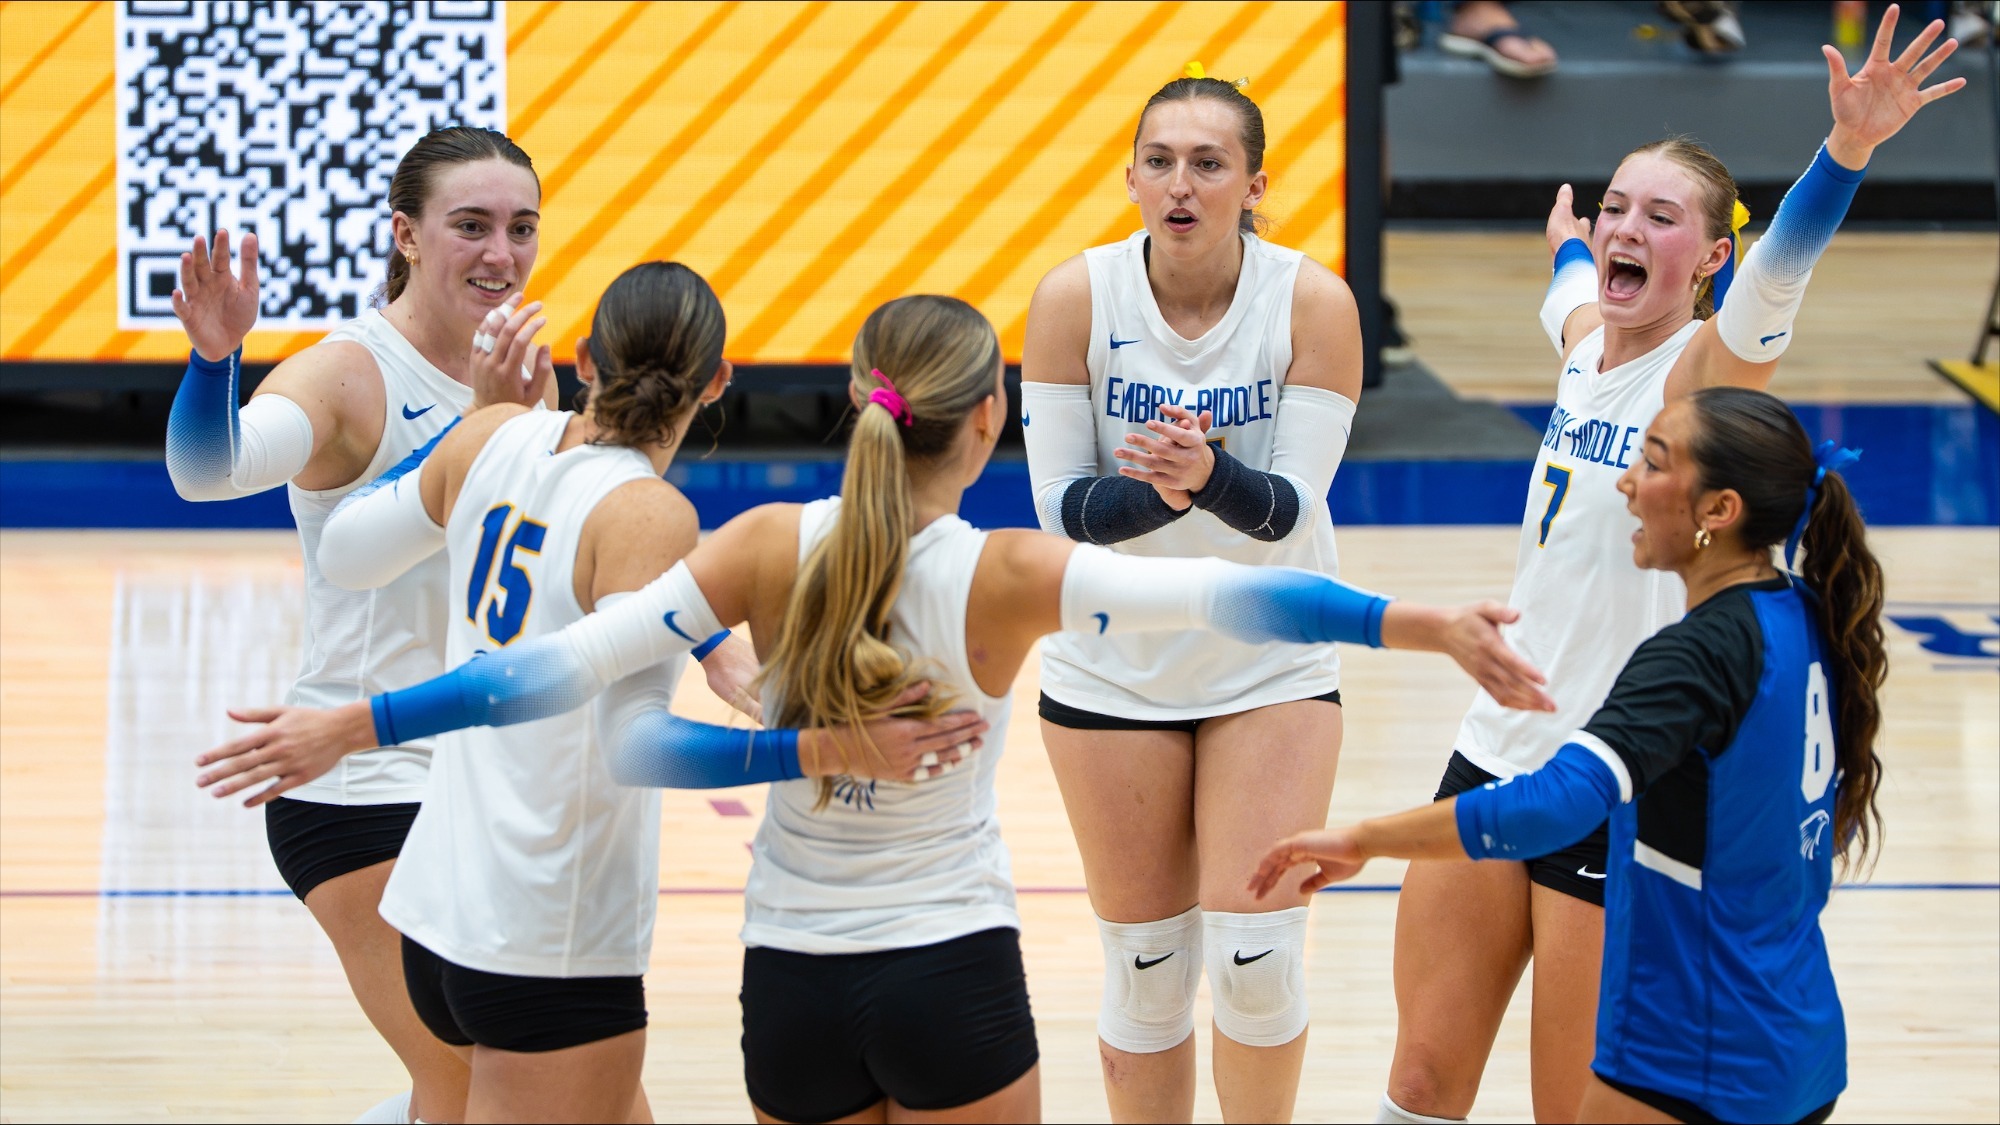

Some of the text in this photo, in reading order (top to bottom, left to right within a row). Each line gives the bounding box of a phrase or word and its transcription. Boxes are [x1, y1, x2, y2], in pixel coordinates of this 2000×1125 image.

[465, 500, 549, 647] 15
[1538, 461, 1573, 548] 7
[1800, 661, 1836, 804] 8
